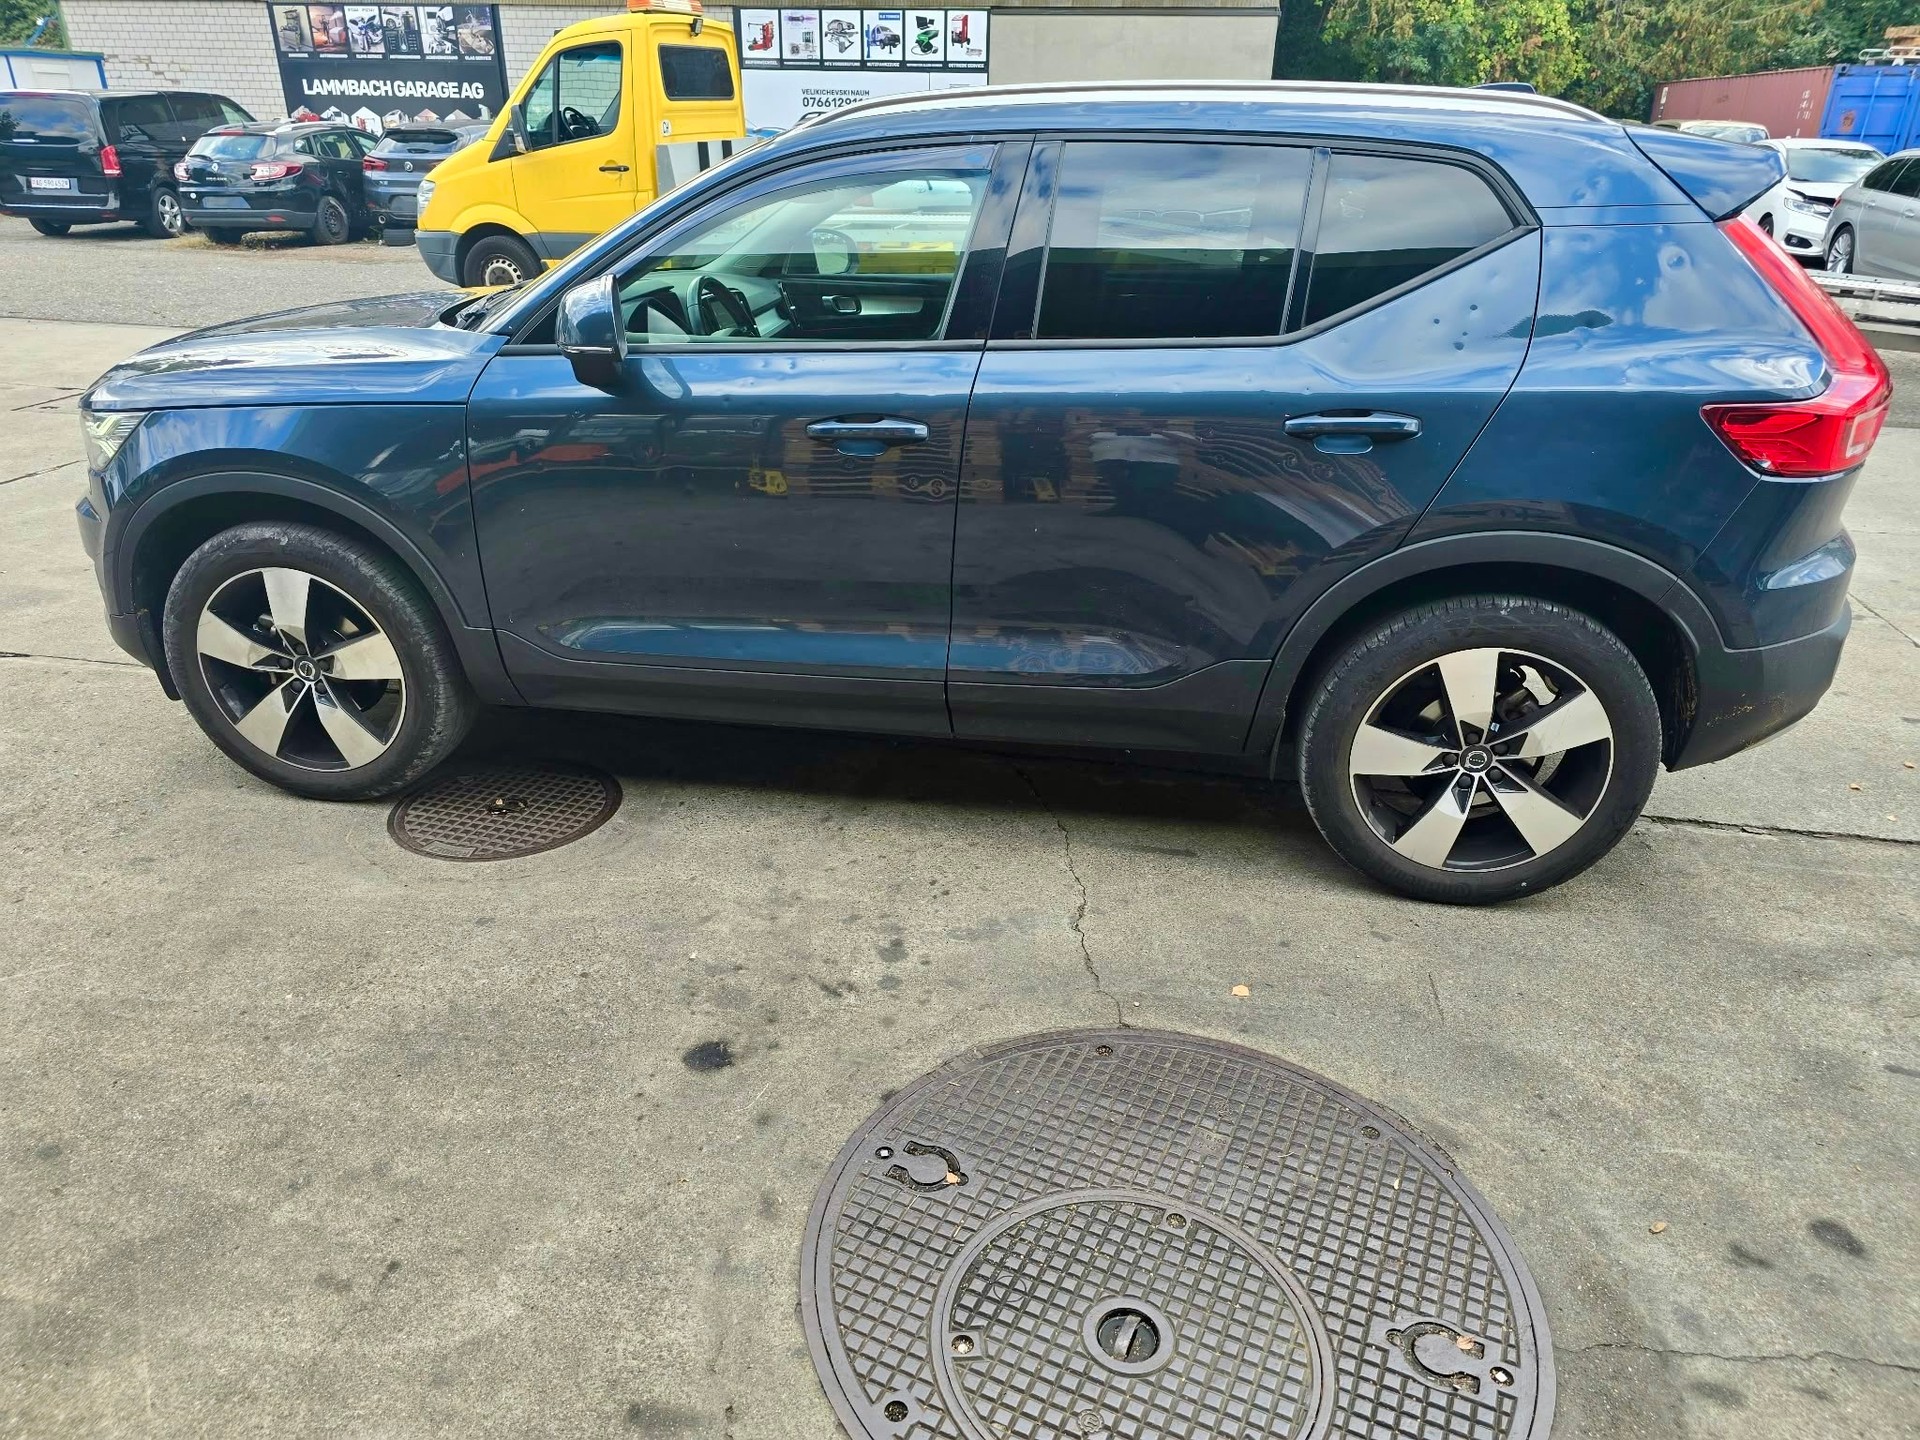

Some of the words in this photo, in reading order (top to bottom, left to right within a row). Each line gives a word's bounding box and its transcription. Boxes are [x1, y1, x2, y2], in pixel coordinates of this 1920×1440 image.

[302, 78, 393, 97] LAMMBACH
[393, 81, 460, 98] GARAGE
[460, 82, 485, 99] AG
